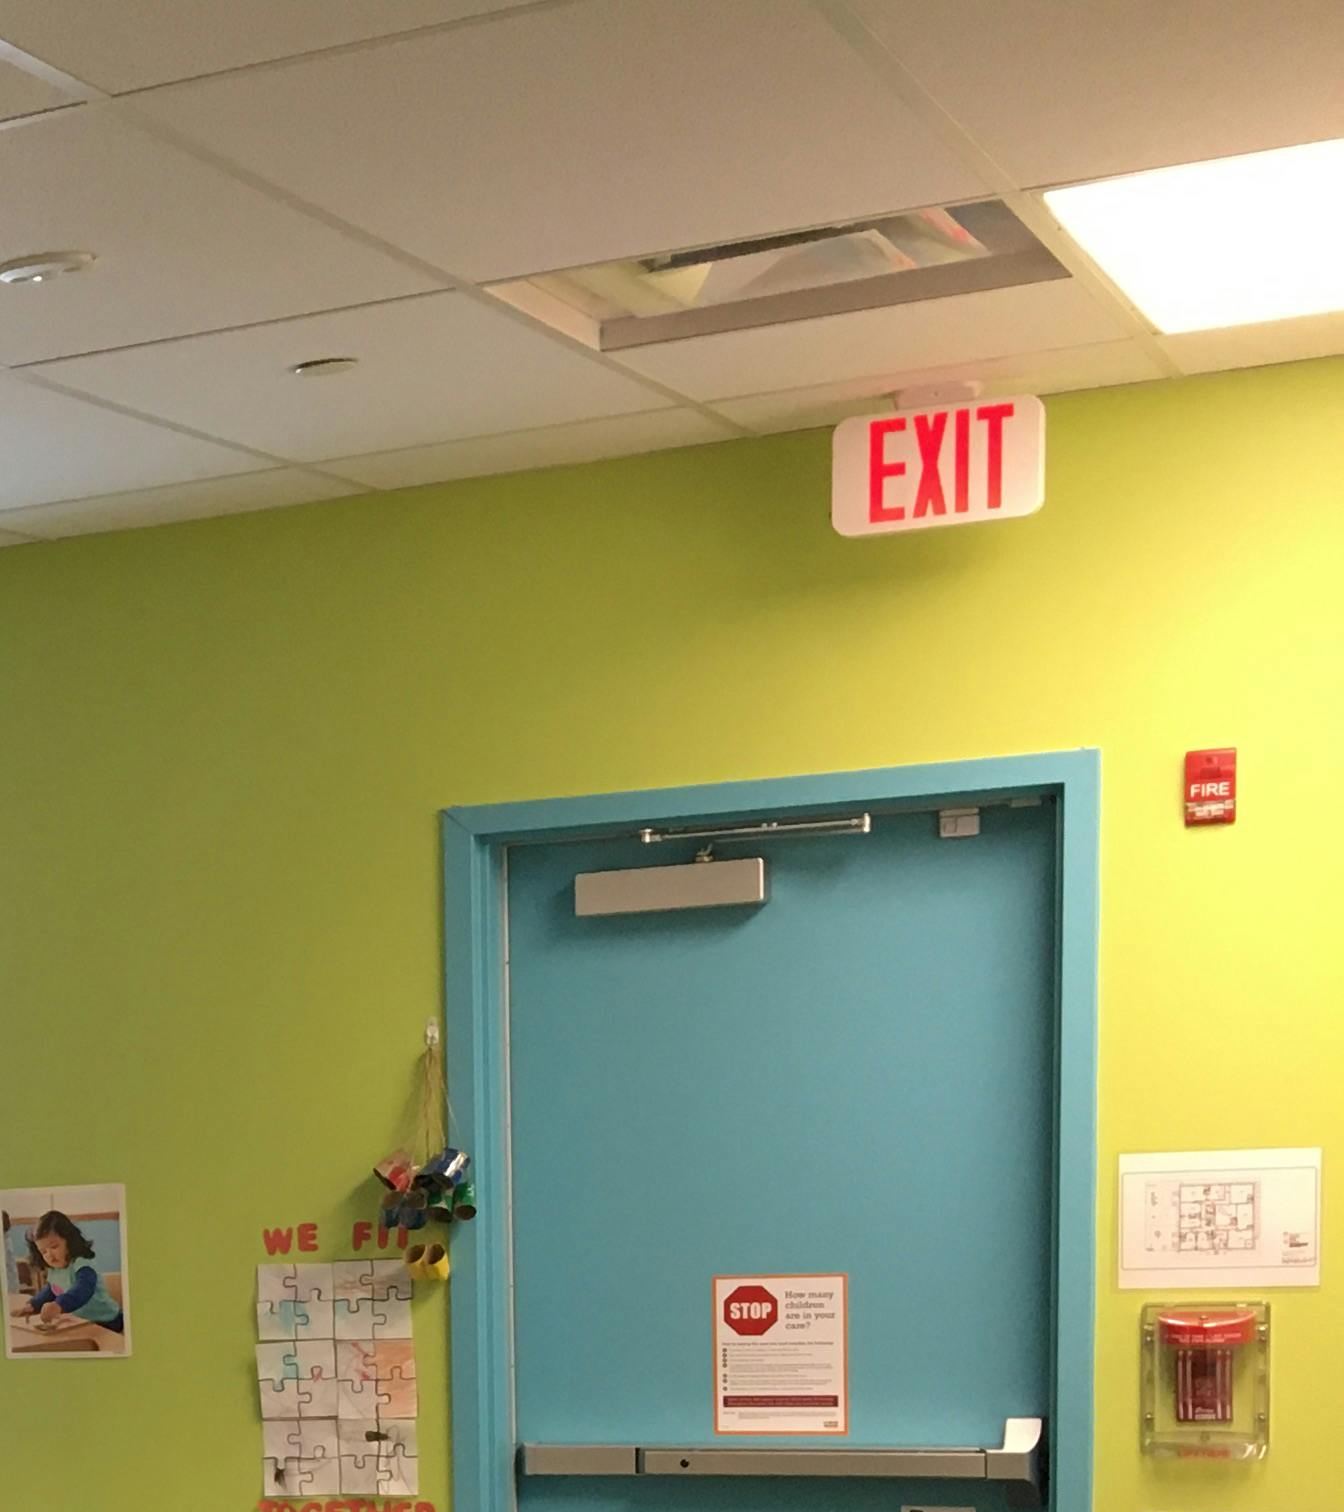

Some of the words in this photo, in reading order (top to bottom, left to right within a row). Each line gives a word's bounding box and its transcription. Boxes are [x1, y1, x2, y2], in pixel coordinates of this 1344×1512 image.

[869, 403, 1014, 523] EXIT
[1190, 782, 1230, 798] FIRE
[263, 1223, 319, 1256] WE
[785, 1291, 806, 1299] How
[808, 1291, 834, 1300] many
[730, 1302, 772, 1320] STOP
[785, 1301, 825, 1310] children
[803, 1311, 812, 1319] in
[814, 1312, 836, 1321] your
[785, 1322, 811, 1330] care?
